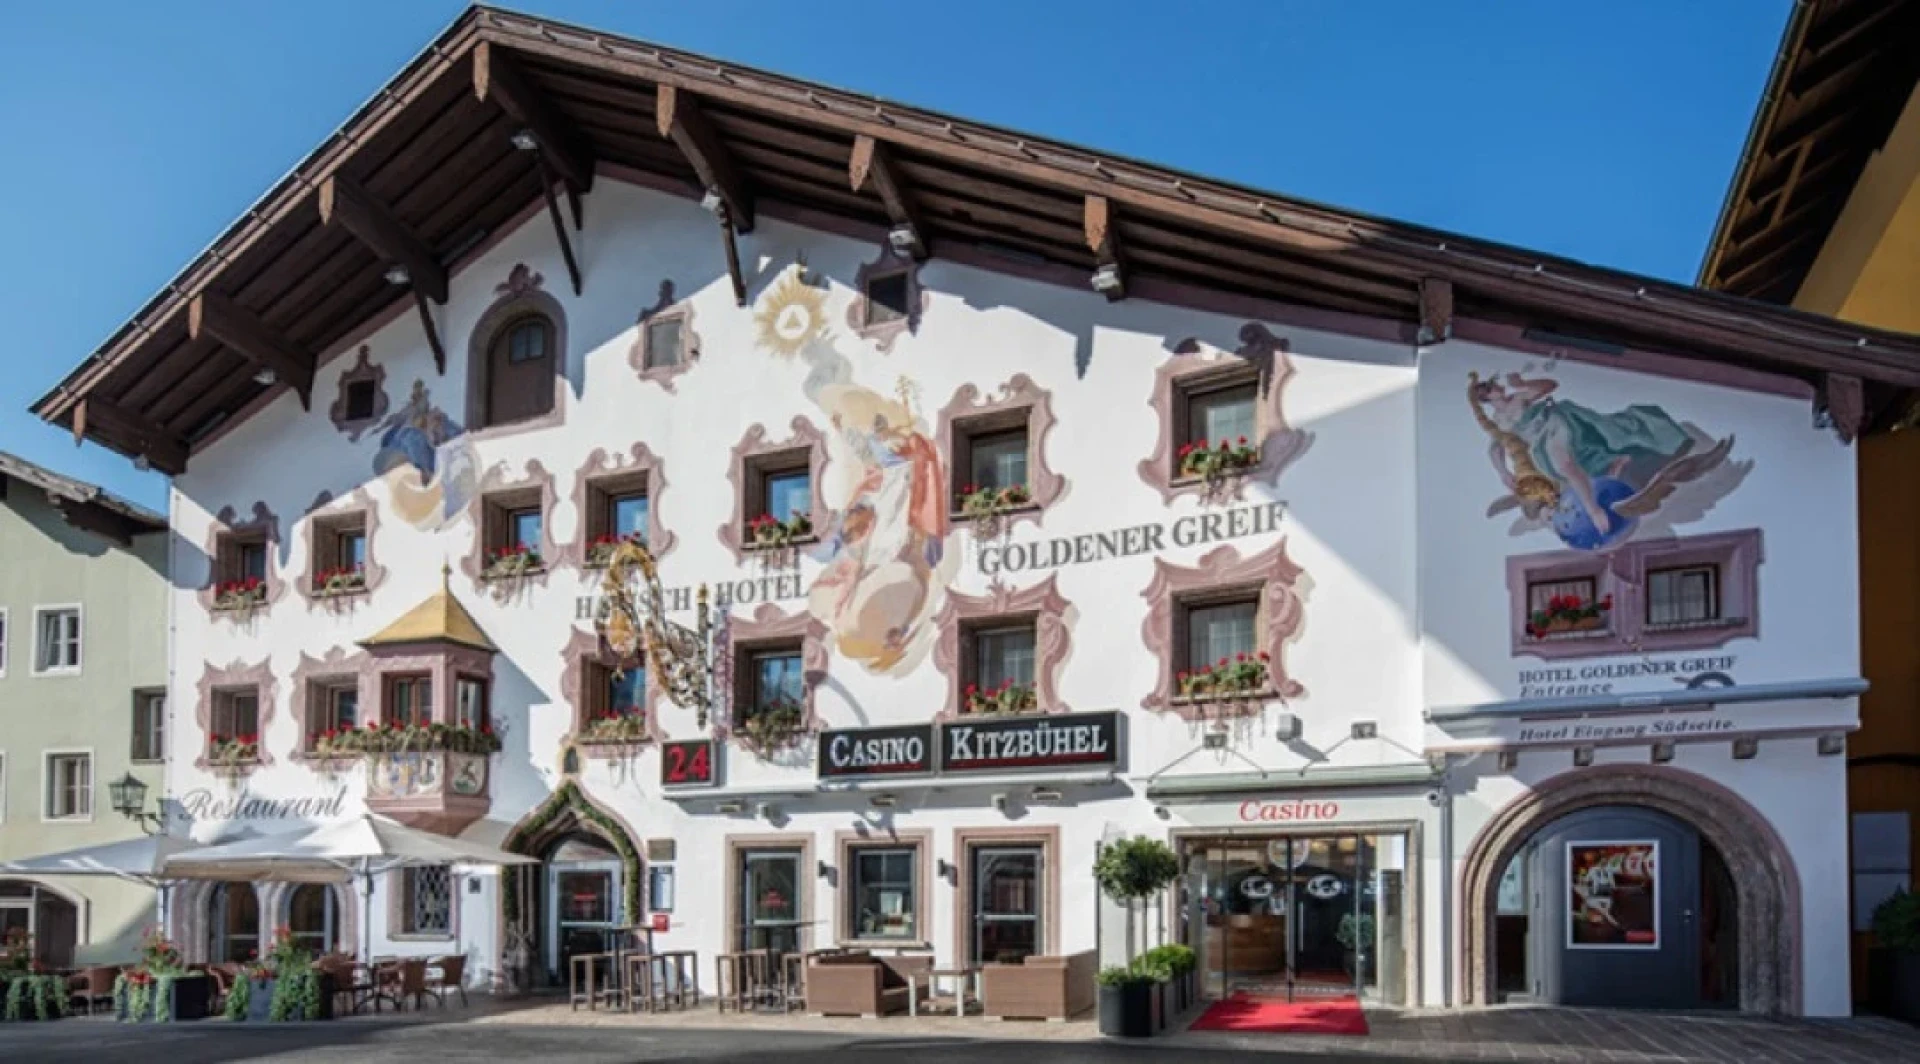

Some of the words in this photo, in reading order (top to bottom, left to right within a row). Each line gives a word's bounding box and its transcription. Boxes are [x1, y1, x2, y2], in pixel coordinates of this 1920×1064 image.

[715, 574, 811, 606] HOTEL
[978, 523, 1166, 575] GOLDENER
[1172, 501, 1288, 547] GREIF
[1519, 668, 1577, 684] HOTEL
[1580, 659, 1677, 679] GOLDENER
[1681, 655, 1738, 673] GREIF
[1520, 726, 1568, 741] Hotel
[1574, 724, 1647, 739] Eingang
[667, 744, 711, 783] 24
[179, 784, 348, 820] Restaurant
[1239, 798, 1339, 822] Casino
